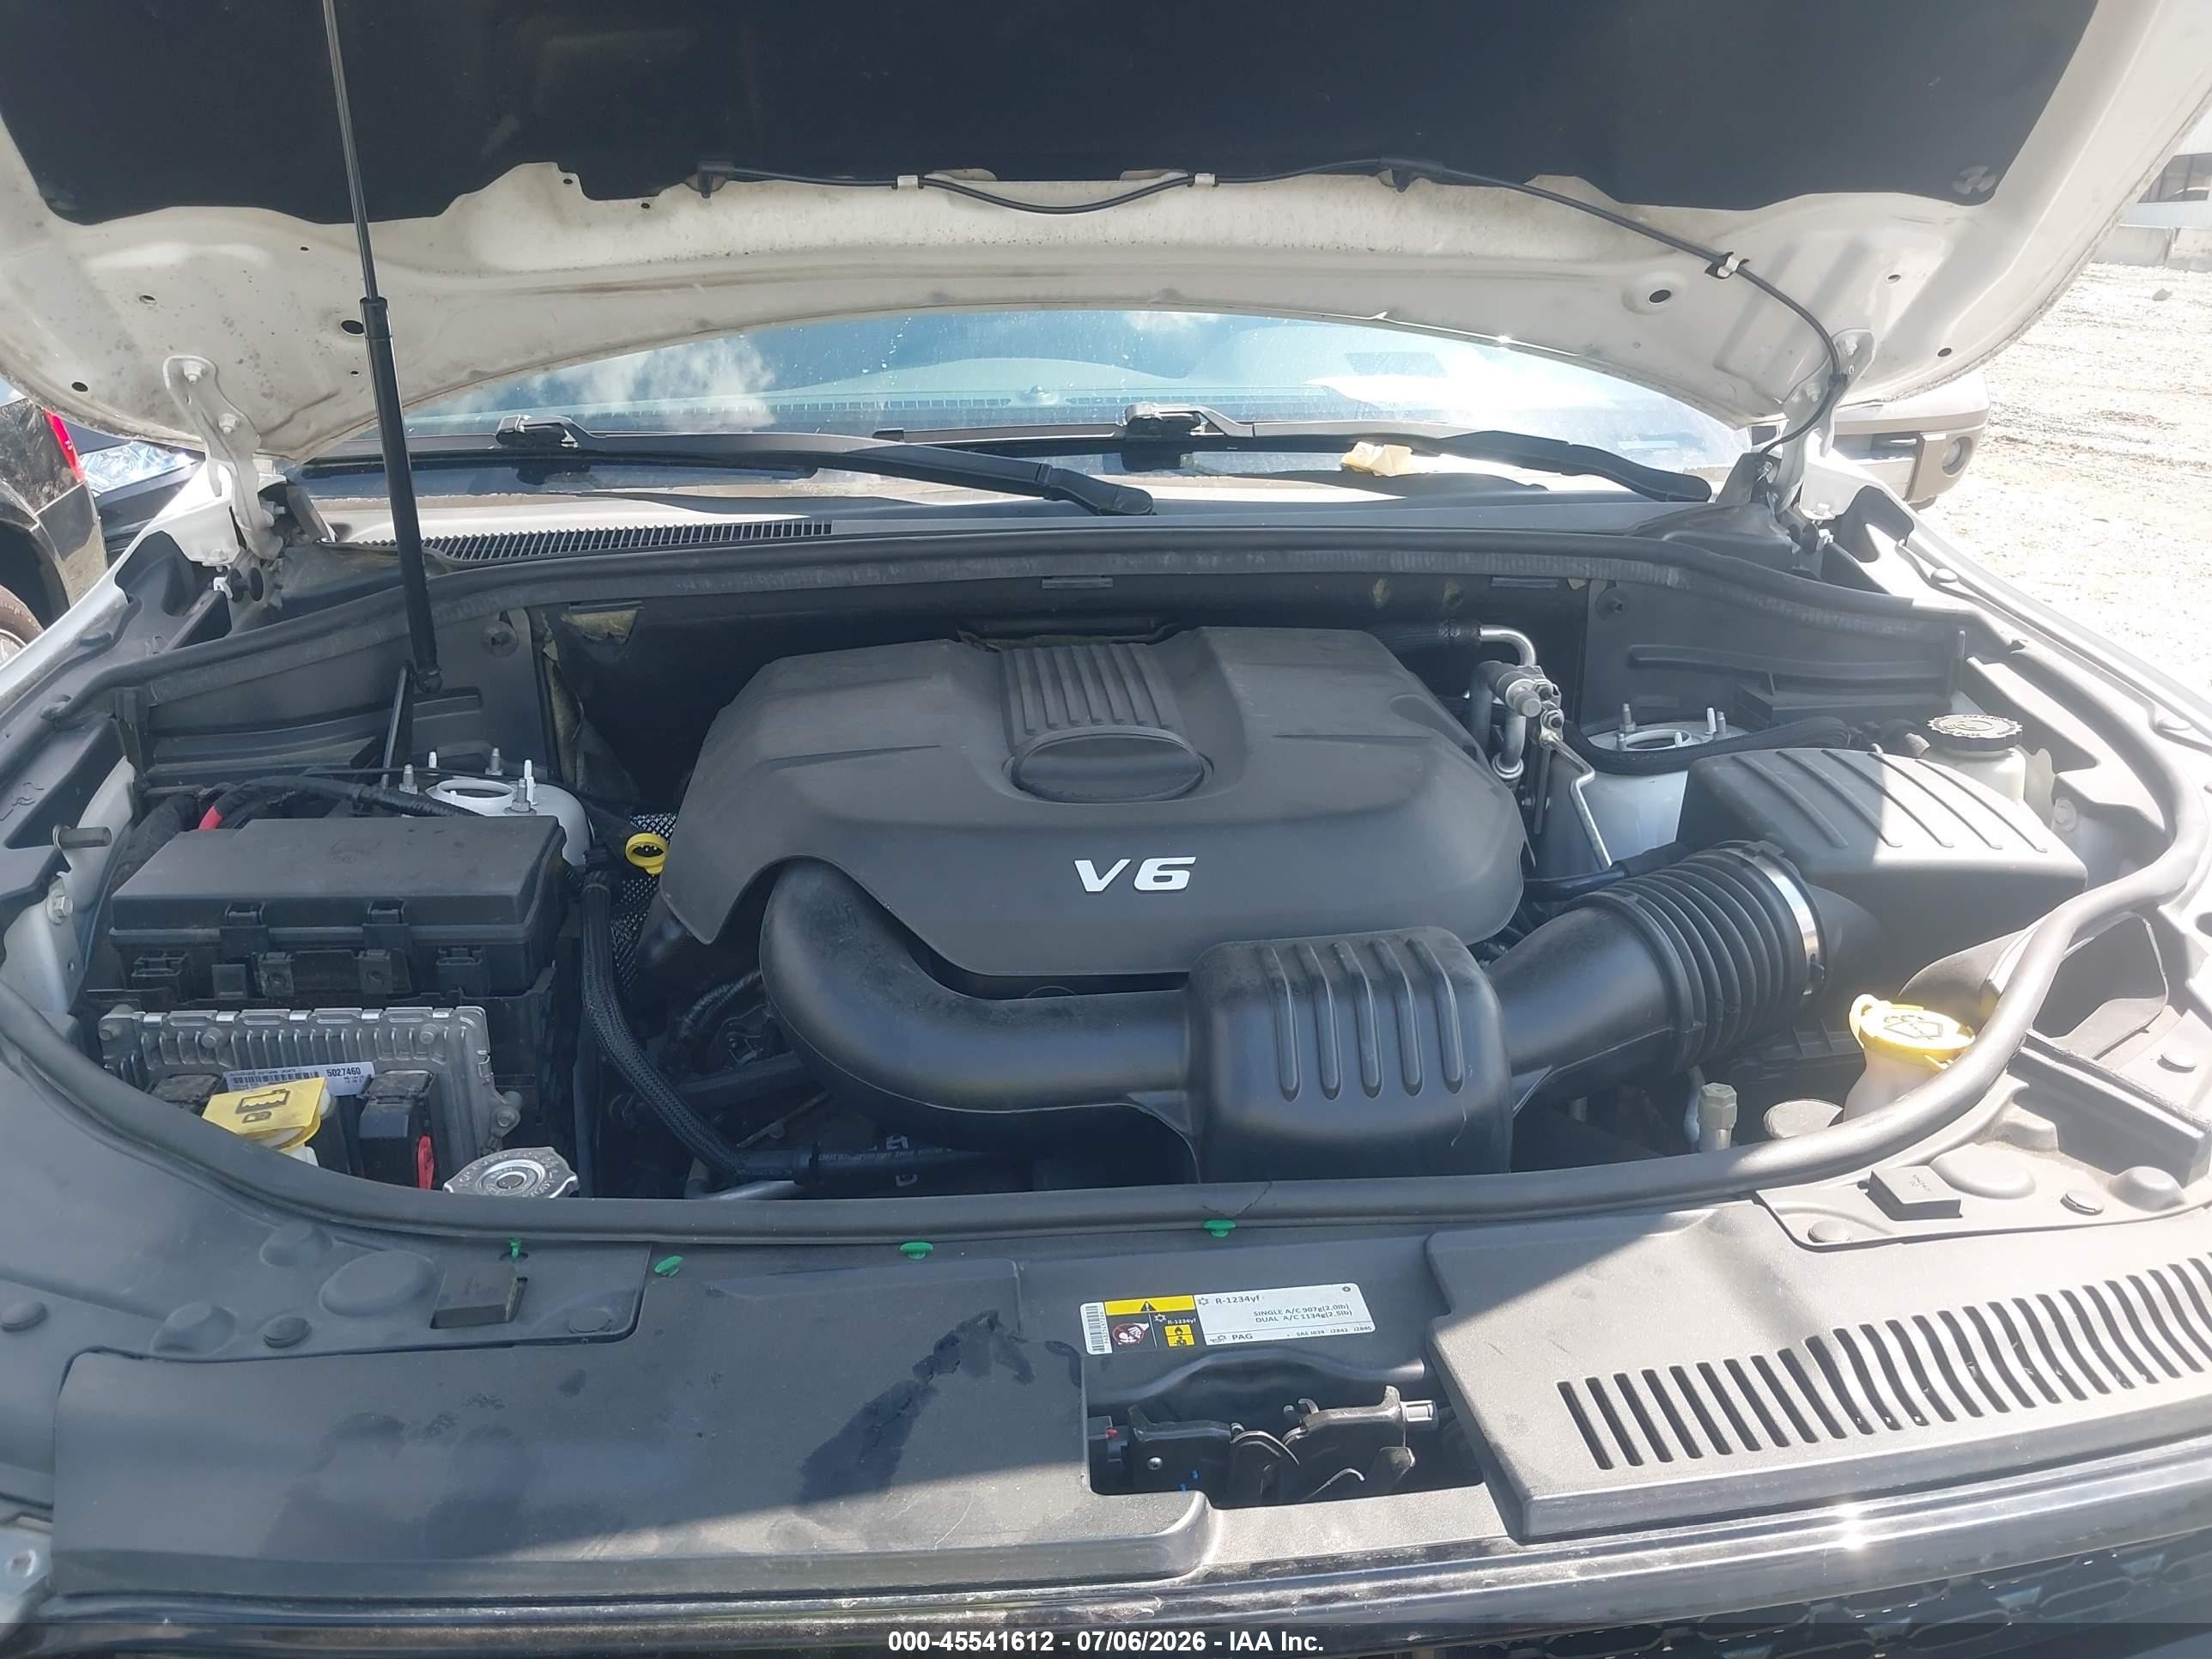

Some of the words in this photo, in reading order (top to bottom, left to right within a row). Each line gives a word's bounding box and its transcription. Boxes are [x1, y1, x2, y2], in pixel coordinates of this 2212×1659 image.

[1074, 856, 1197, 893] V6
[325, 1066, 362, 1078] 5027460
[1215, 1294, 1260, 1304] R-1234yf
[1254, 1307, 1283, 1316] SINGLE
[1285, 1306, 1300, 1316] A/C
[1283, 1313, 1298, 1322] A/C
